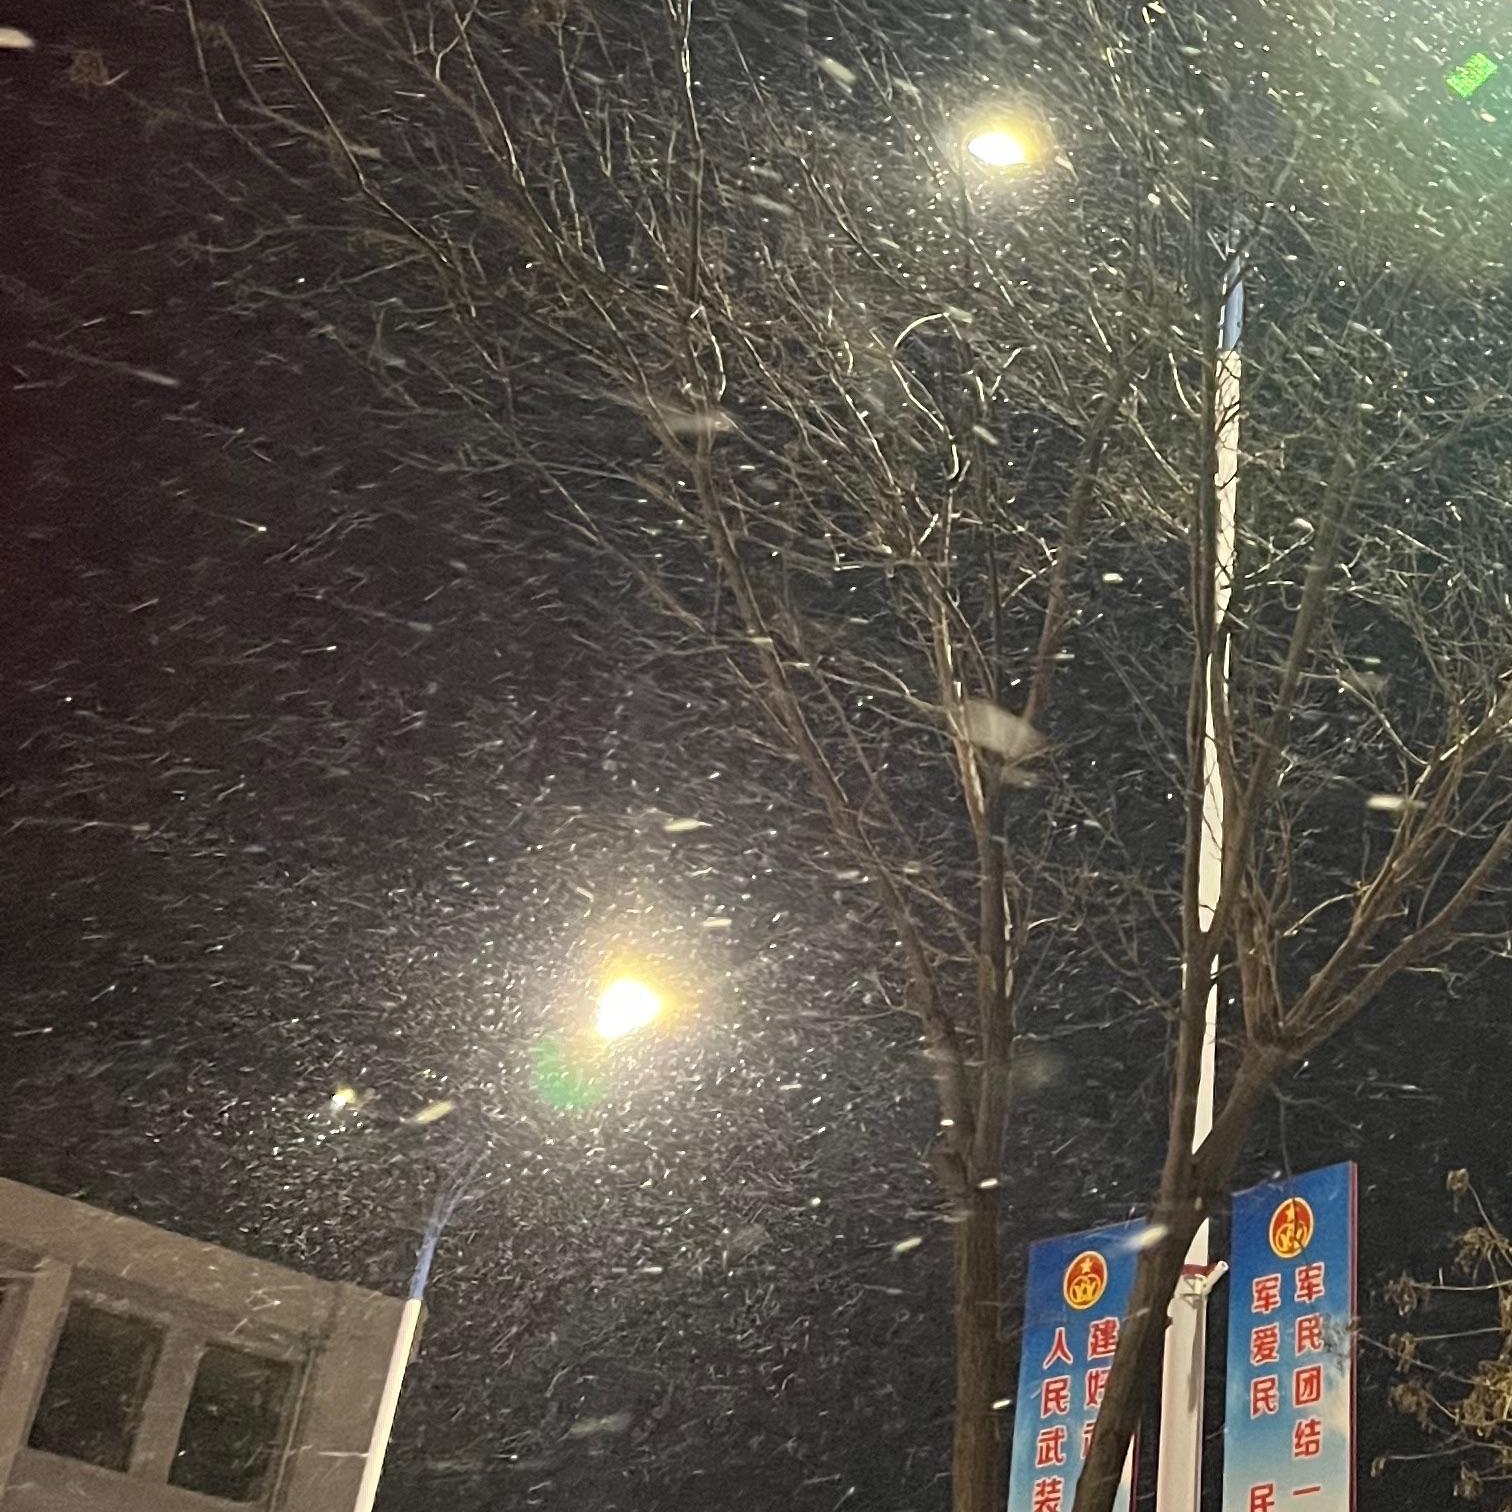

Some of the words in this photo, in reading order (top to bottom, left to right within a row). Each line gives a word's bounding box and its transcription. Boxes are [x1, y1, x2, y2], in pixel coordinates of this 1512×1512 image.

[1033, 1327, 1073, 1512] 人民武装
[1250, 1274, 1281, 1419] 军爱民
[1292, 1262, 1325, 1497] 军民团结一
